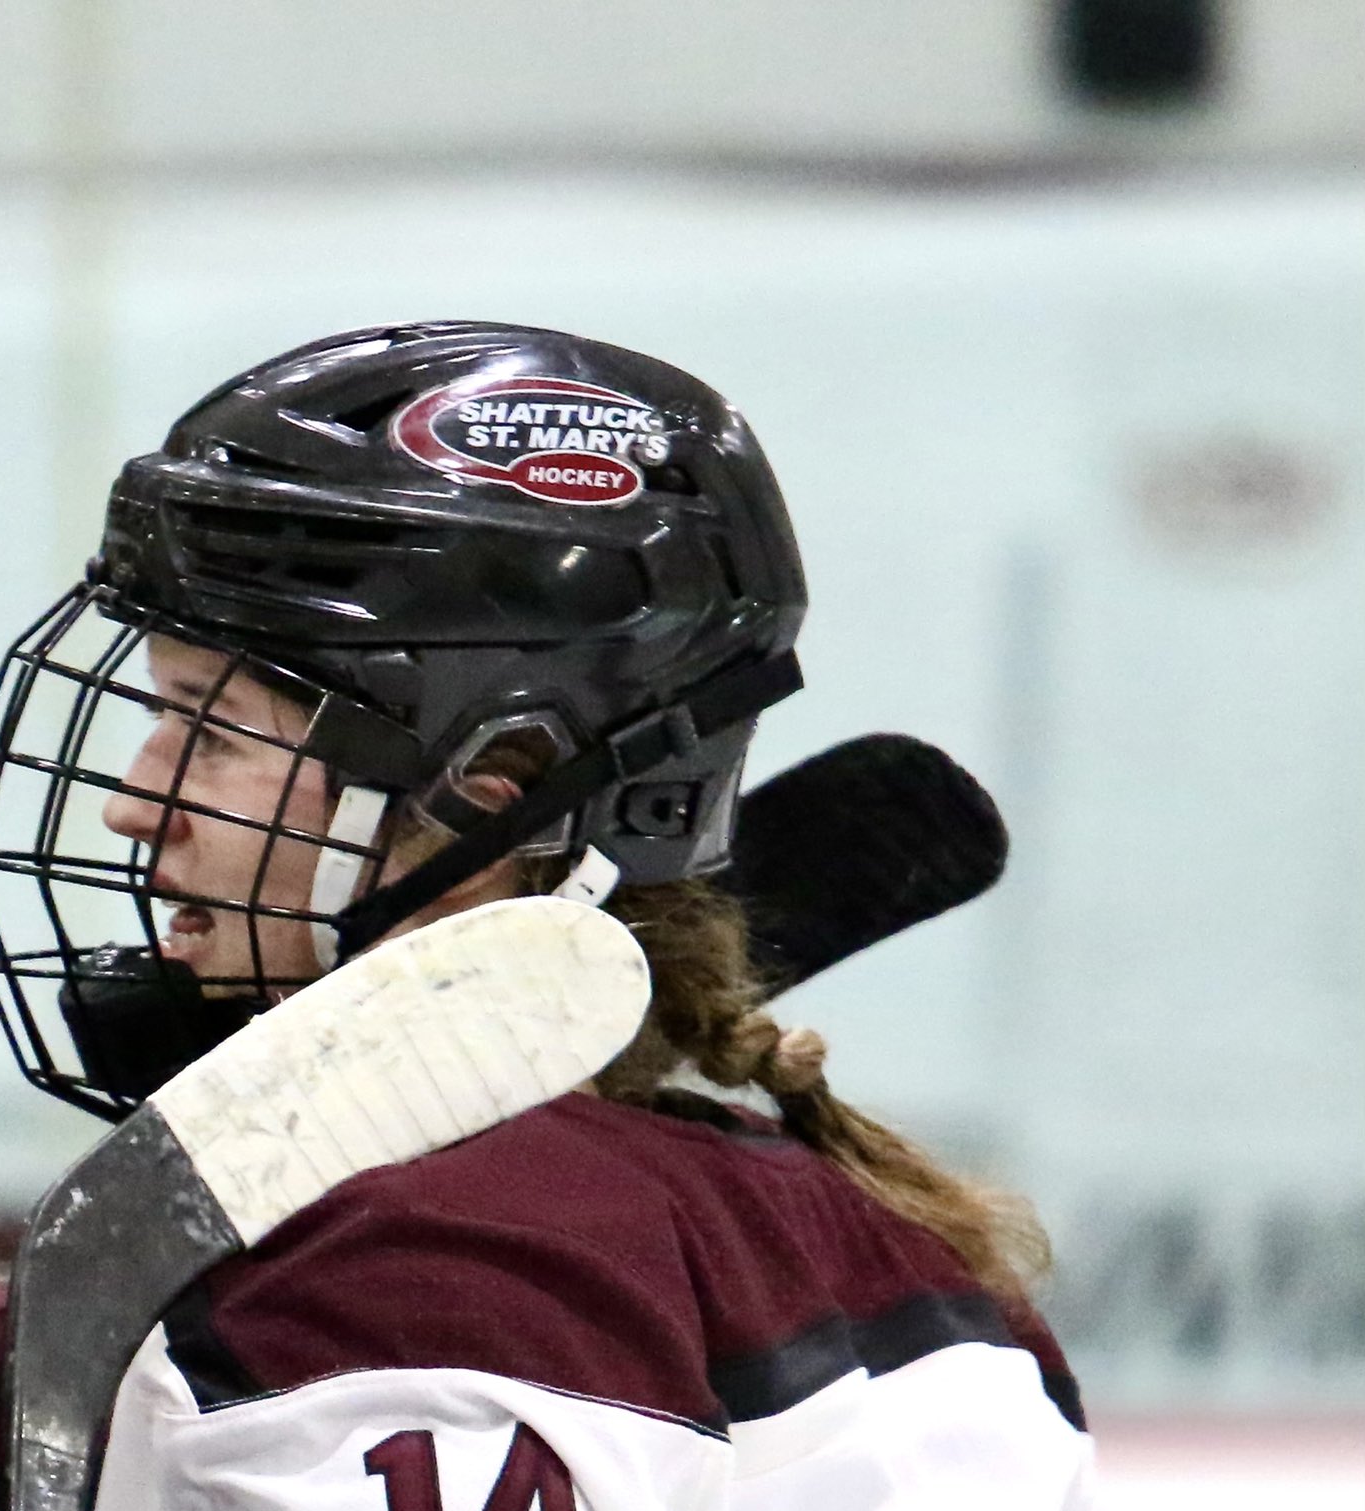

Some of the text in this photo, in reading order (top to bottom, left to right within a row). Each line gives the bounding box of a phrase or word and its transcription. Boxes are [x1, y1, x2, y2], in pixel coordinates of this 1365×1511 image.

[457, 402, 661, 432] SHATTUCK-
[466, 425, 670, 459] ST. MARY'S
[527, 466, 626, 489] HOCKEY
